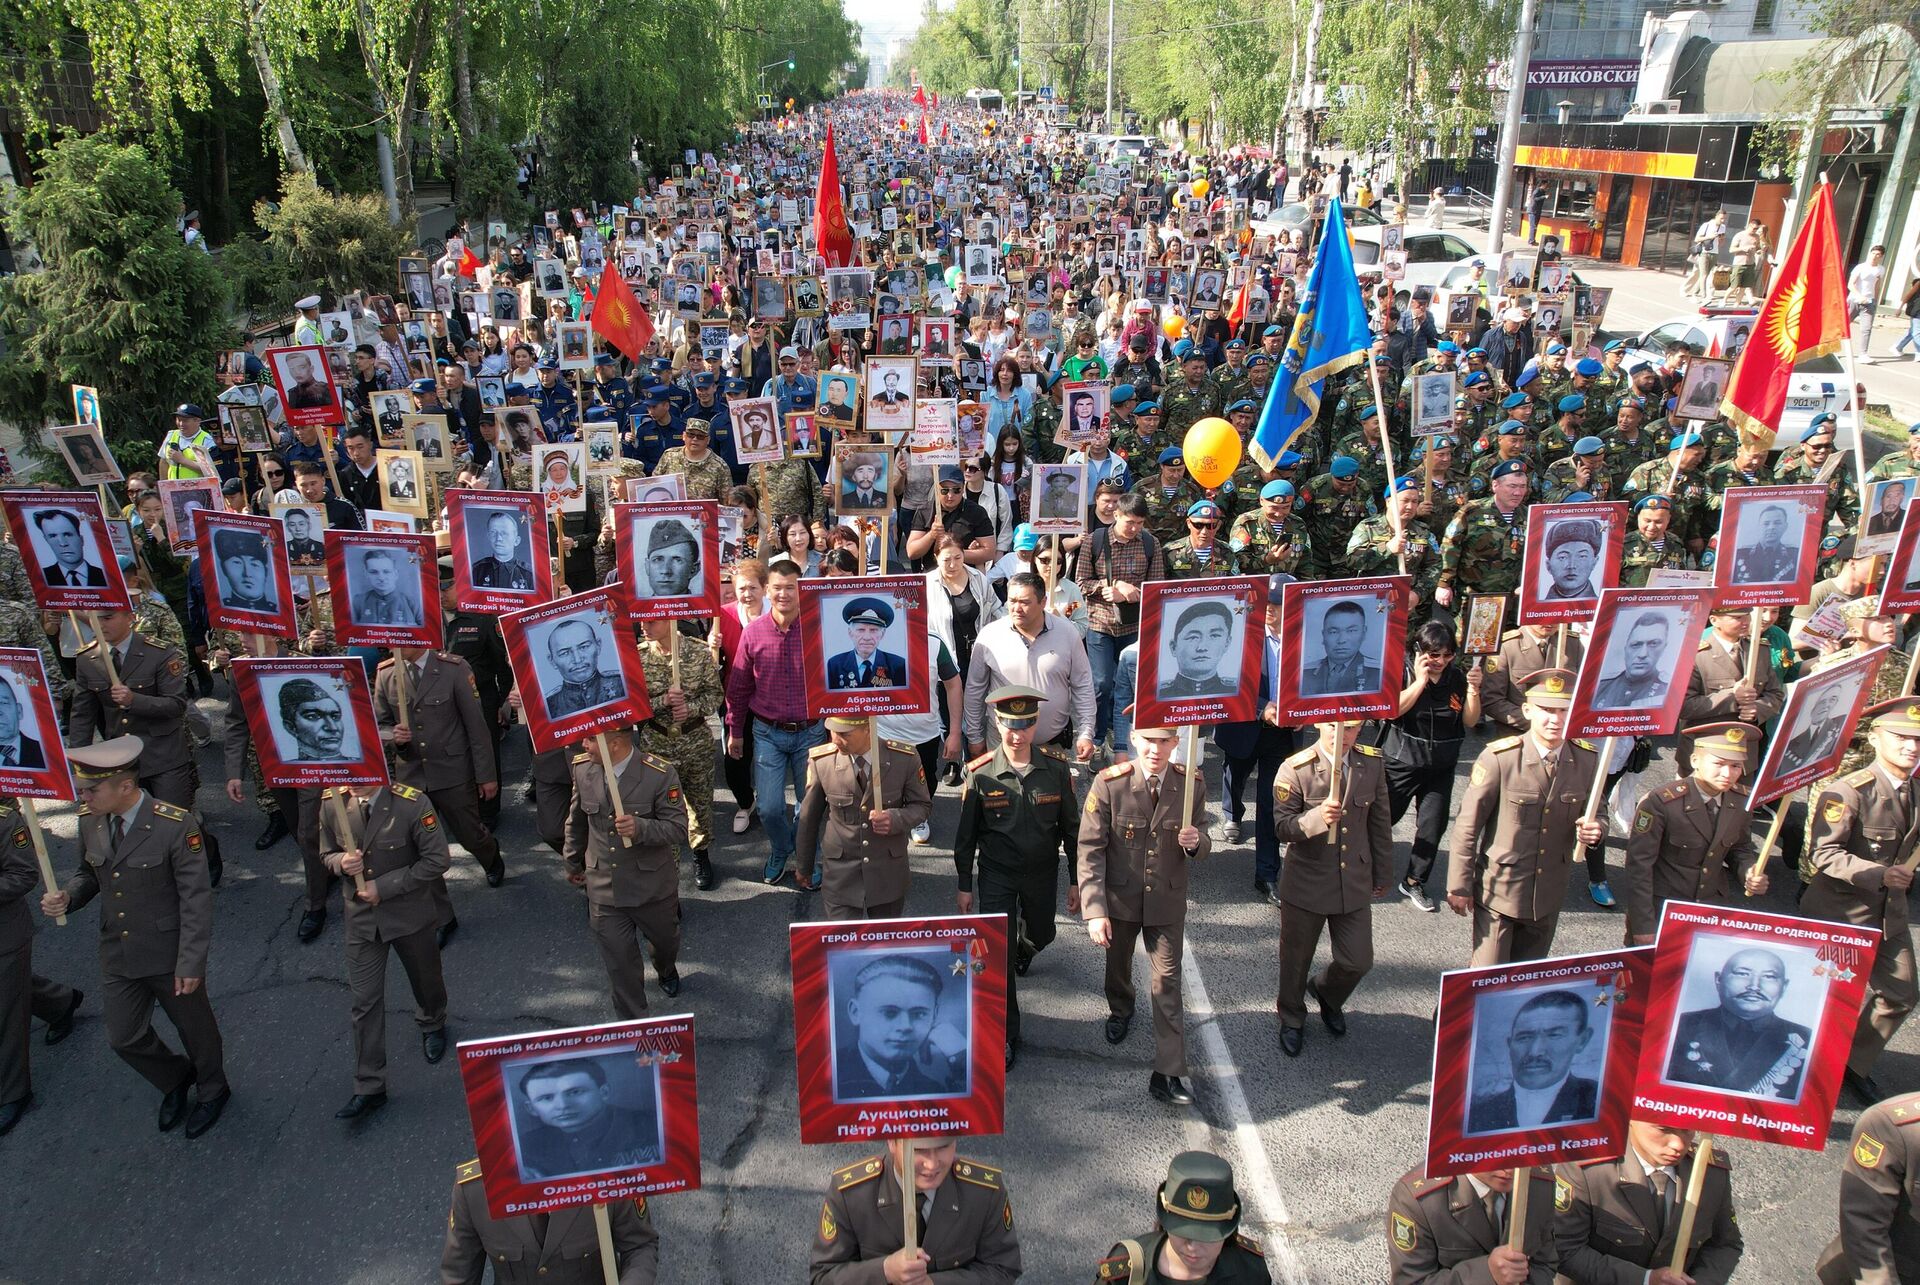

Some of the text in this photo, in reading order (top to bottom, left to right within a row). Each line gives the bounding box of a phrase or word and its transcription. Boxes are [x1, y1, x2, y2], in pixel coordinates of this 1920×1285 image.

[1527, 70, 1640, 84] КУЛИКОВСКИ
[1793, 398, 1809, 407] 901
[221, 517, 252, 526] СОВЕТСКОГО
[801, 582, 832, 591] ПОЛНЫЙ
[1160, 586, 1182, 594] ГЕРОЙ
[1183, 585, 1226, 593] СОВЕТСКОГО
[1301, 586, 1323, 594] ГЕРОЙ
[1325, 584, 1367, 592] СОВЕТСКОГО
[461, 602, 497, 611] Григорий
[518, 594, 608, 624] ГЕРОЙ СОВЕТСКОГО СОЮЗА
[630, 608, 713, 618] Николай Яковлевич
[220, 616, 287, 631] Оторбаев Асанбек
[367, 629, 412, 638] Панфилов
[348, 637, 432, 646] Дмитрий Иванович
[1807, 656, 1875, 688] ГЕРОЙ СОВЕТСКОГО СОЮЗА
[846, 696, 891, 704] Абрамов
[819, 703, 919, 714] Алексей Фёдорович
[1170, 703, 1224, 713] Таранчиев
[1287, 704, 1391, 718] Тешебаев Мамасалы
[1163, 712, 1229, 723] Ысмайылбек
[1597, 715, 1651, 723] Колесников
[554, 709, 633, 739] Ванахун Манзус
[1582, 724, 1660, 734] Пётр Федосеевич
[301, 768, 349, 776] Петренко
[272, 776, 319, 785] Григорий
[1, 785, 58, 796] Васильевич
[1669, 911, 1873, 948] ПОЛНЫЙ КАВАЛЕР ОРДЕНОВ СЛАВЫ
[821, 928, 977, 943] ГЕРОЙ СОВЕТСКОГО СОЮЗА
[1472, 961, 1625, 987] ГЕРОЙ СОВЕТСКОГО СОЮЗА
[466, 1024, 688, 1058] ПОЛНЫЙ КАВАЛЕР ОРДЕНОВ СЛАВЫ
[858, 1107, 949, 1122] Аукционок
[1633, 1095, 1815, 1135] Кадыркулов Ыдырыс
[837, 1121, 969, 1136] Пётр Антонович
[1448, 1136, 1609, 1164] Жаркымбаев Казак
[543, 1172, 647, 1195] Ольховский
[505, 1179, 686, 1213] Владимир Сергеевич
